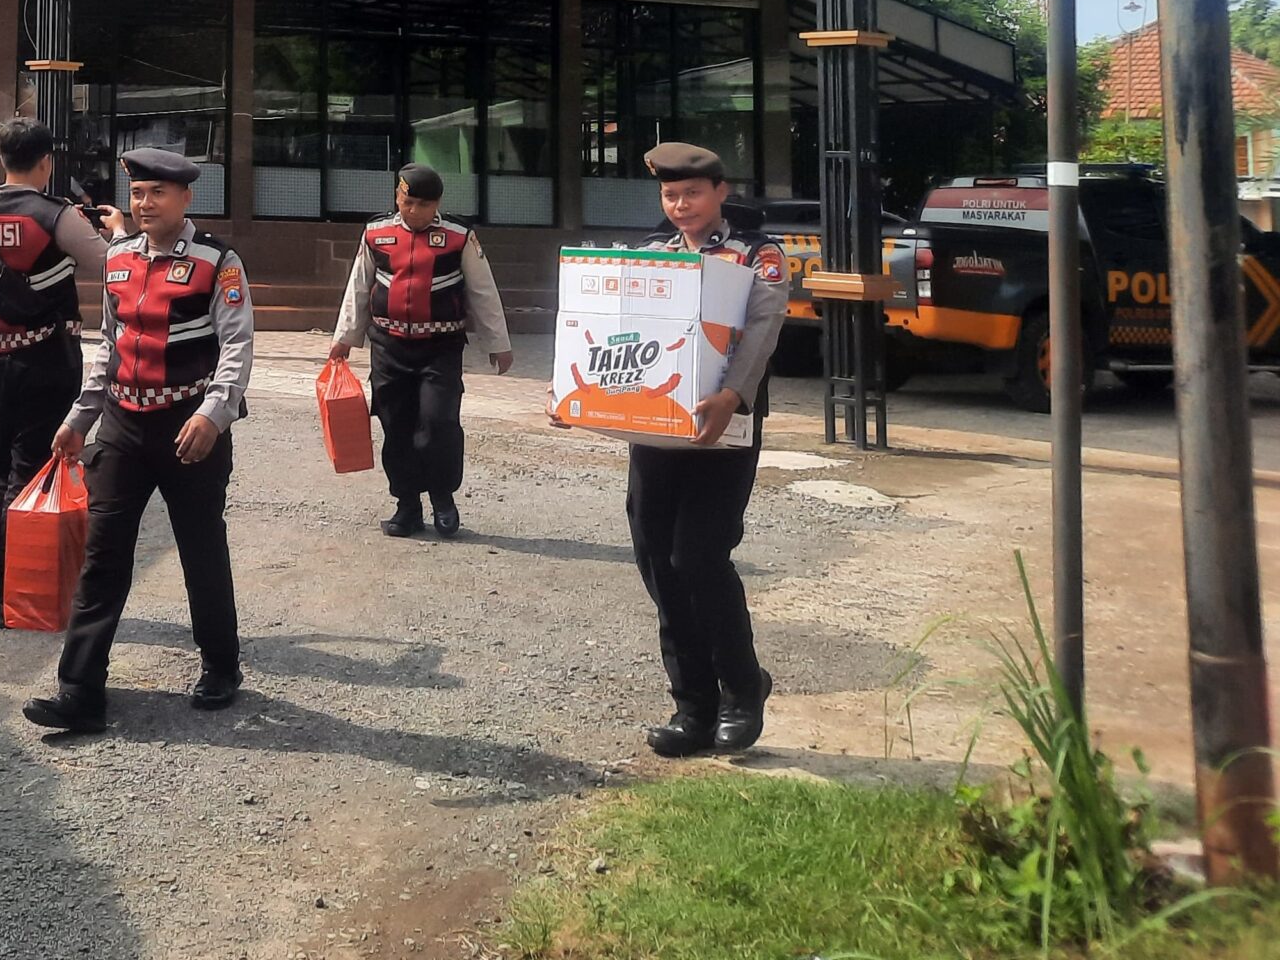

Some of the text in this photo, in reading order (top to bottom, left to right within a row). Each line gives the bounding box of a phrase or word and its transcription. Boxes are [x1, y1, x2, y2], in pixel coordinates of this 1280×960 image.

[962, 199, 1027, 209] POLRI UNTUK
[962, 210, 1027, 221] MASYARAKAT
[1107, 271, 1175, 305] POL
[599, 369, 644, 388] KREZZ
